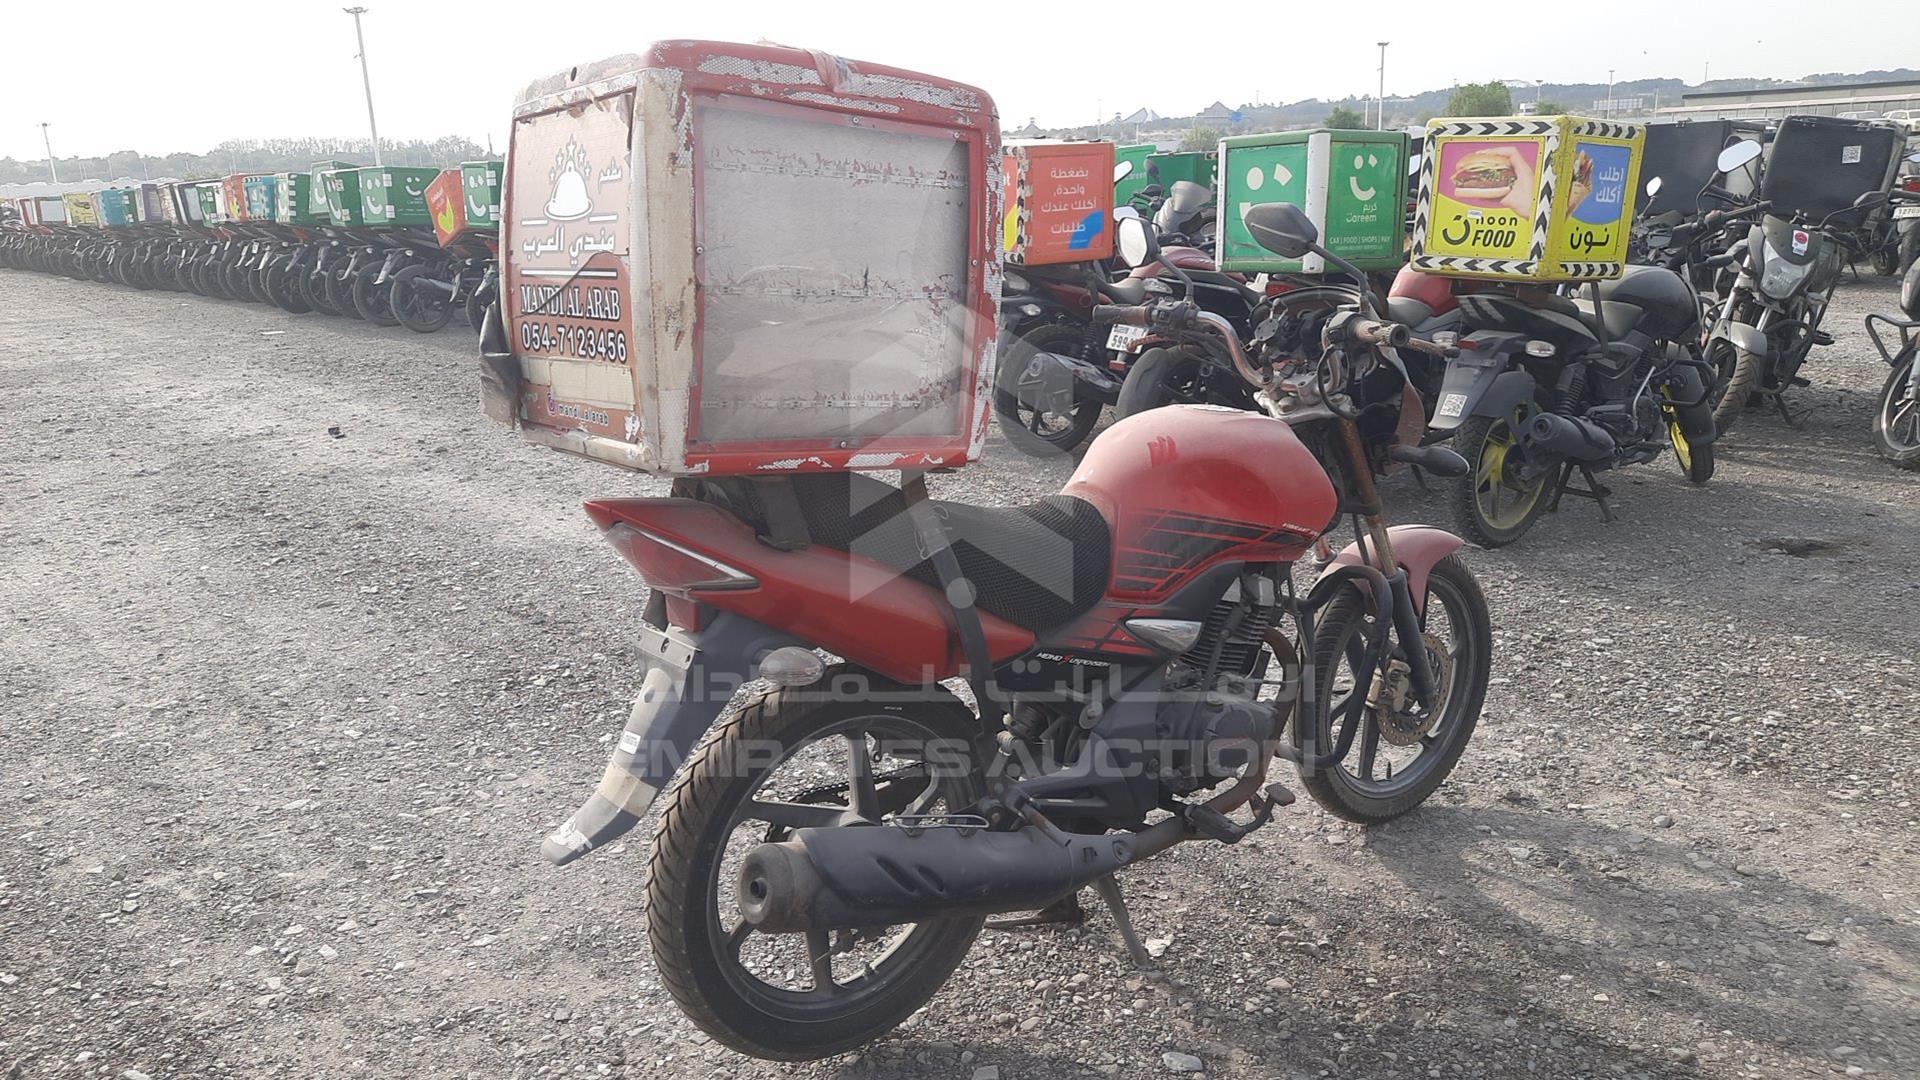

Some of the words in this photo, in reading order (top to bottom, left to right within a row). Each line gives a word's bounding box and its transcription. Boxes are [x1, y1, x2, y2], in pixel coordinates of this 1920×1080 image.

[1471, 229, 1516, 248] FOOD
[1475, 216, 1518, 227] noon
[523, 225, 564, 262] العرب
[569, 229, 615, 266] مندي
[1570, 226, 1610, 254] نون
[521, 286, 564, 316] MANDI
[566, 287, 583, 317] AL
[586, 288, 620, 320] ARAB
[521, 323, 627, 363] 054-7123456
